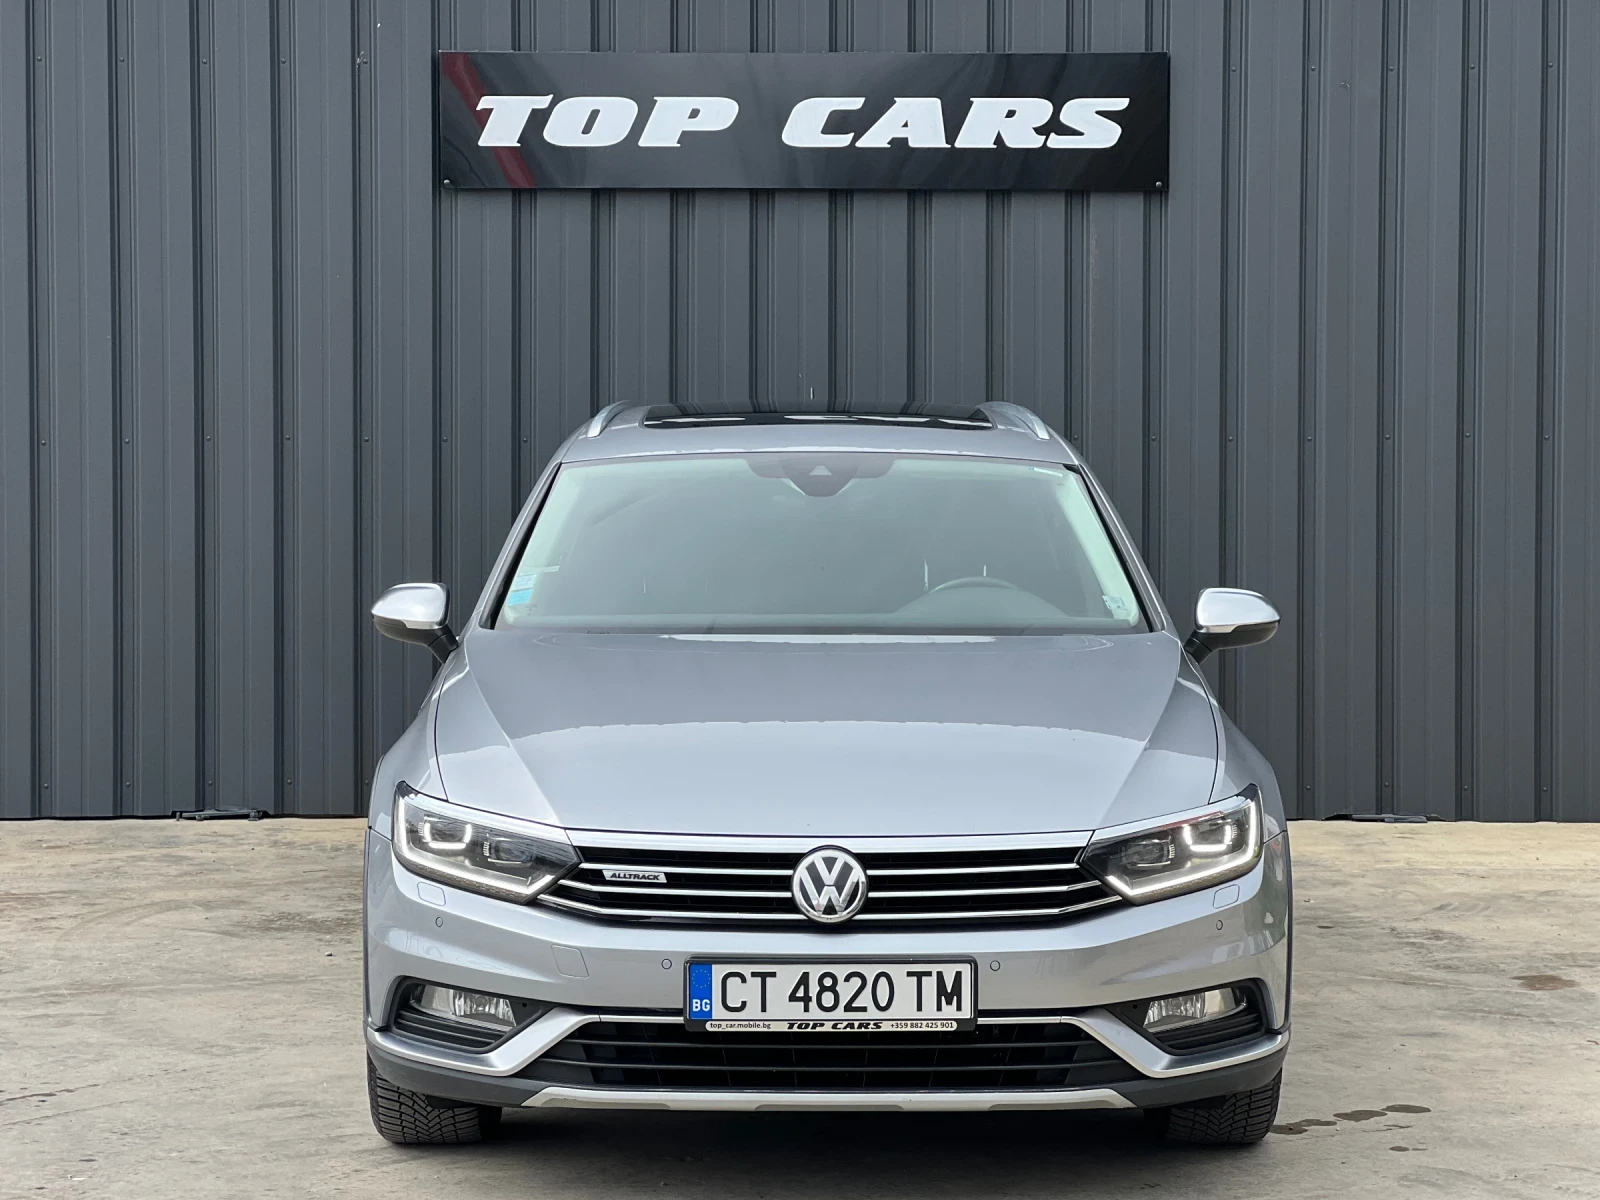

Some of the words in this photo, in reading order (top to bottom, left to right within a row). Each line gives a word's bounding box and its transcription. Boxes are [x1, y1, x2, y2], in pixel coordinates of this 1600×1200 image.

[476, 94, 739, 148] TOP
[781, 97, 1130, 149] CARS
[610, 871, 661, 882] ALLTRACK
[799, 853, 862, 918] VW
[692, 999, 711, 1012] BG
[720, 971, 777, 1013] CT
[788, 971, 895, 1013] 4820
[906, 970, 963, 1012] TM
[710, 1022, 771, 1030] top_car.mobile.bg
[787, 1022, 825, 1030] TOP
[831, 1022, 883, 1030] CARS
